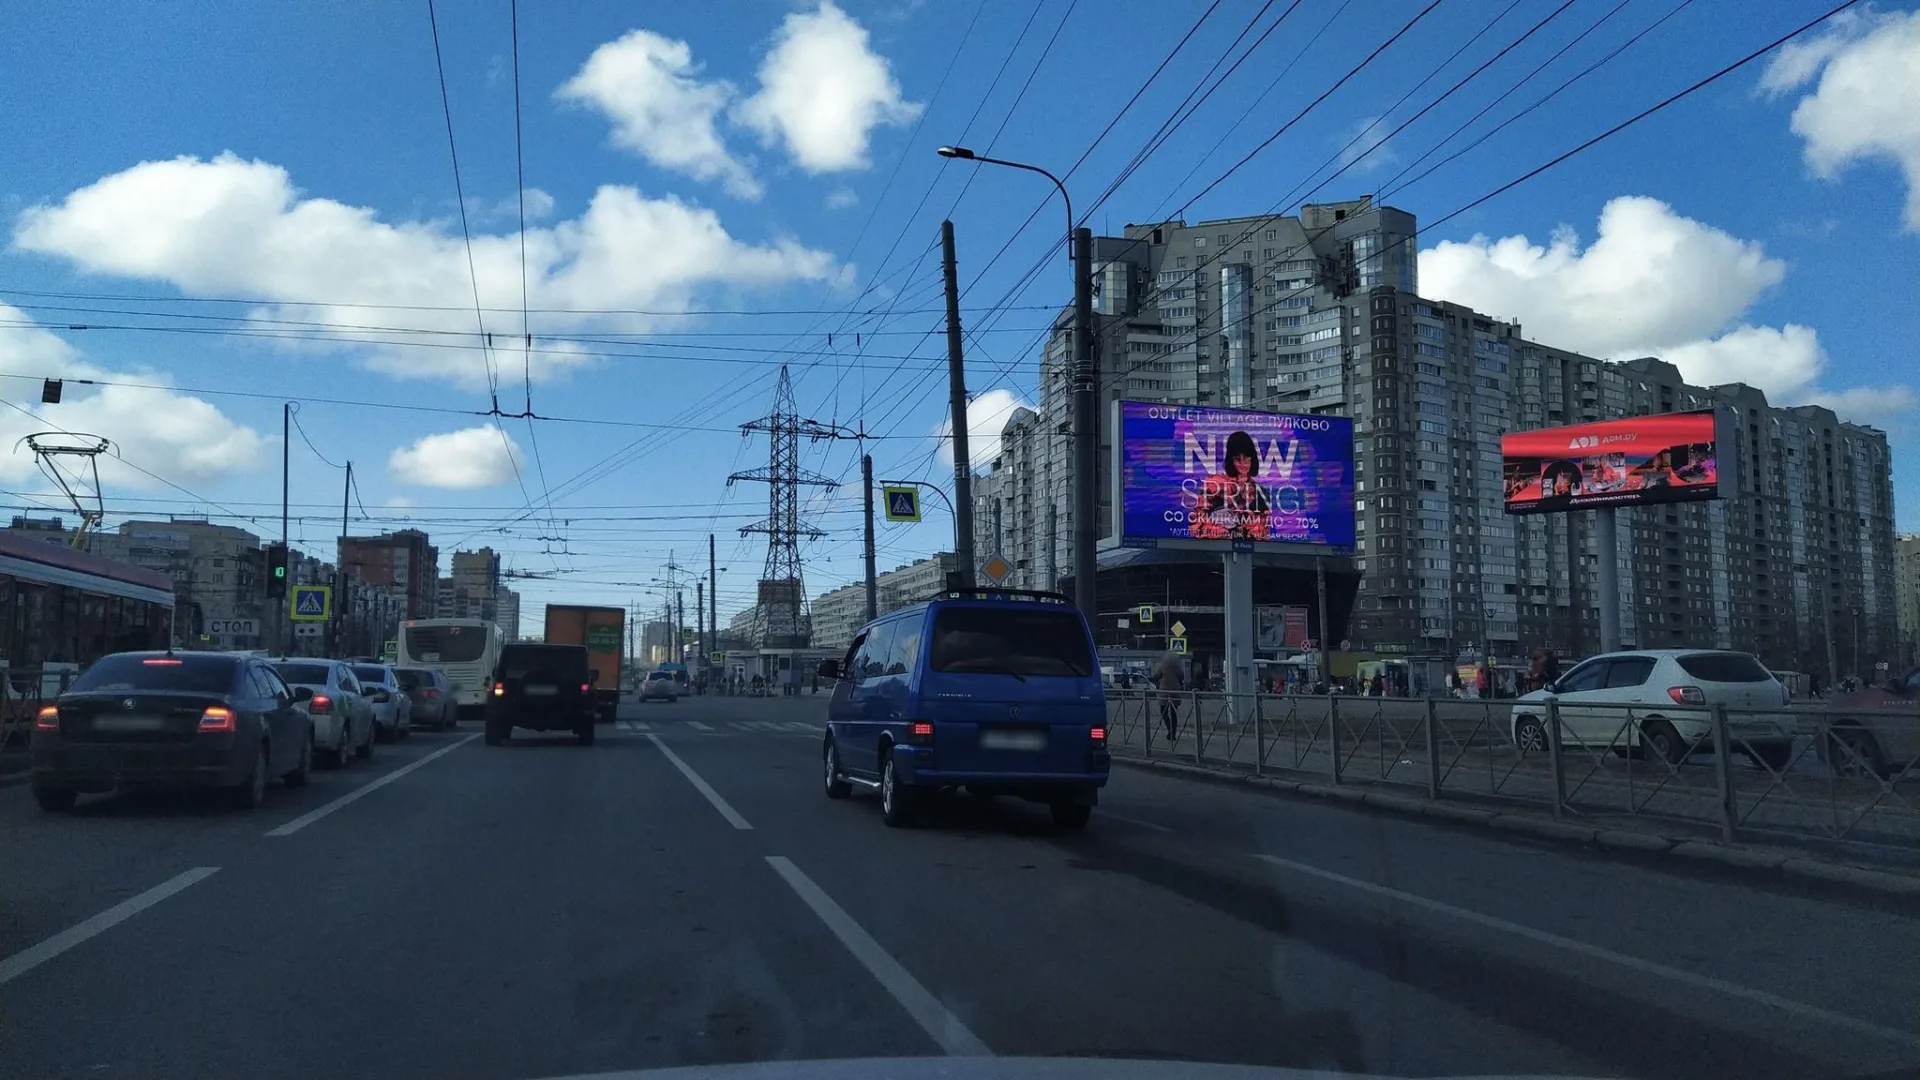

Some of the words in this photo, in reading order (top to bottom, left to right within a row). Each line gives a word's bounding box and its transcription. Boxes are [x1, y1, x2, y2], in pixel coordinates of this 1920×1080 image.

[1148, 407, 1201, 422] OUTLET
[1207, 411, 1262, 426] VILLAGE
[1267, 415, 1330, 431] ПУЛКОВО
[1180, 478, 1300, 515] SPRING
[1163, 510, 1184, 523] СО
[1188, 512, 1262, 525] СКИДКАМИ
[1265, 516, 1284, 529] ДО
[1295, 517, 1319, 530] 70%
[211, 621, 252, 633] СТОП
